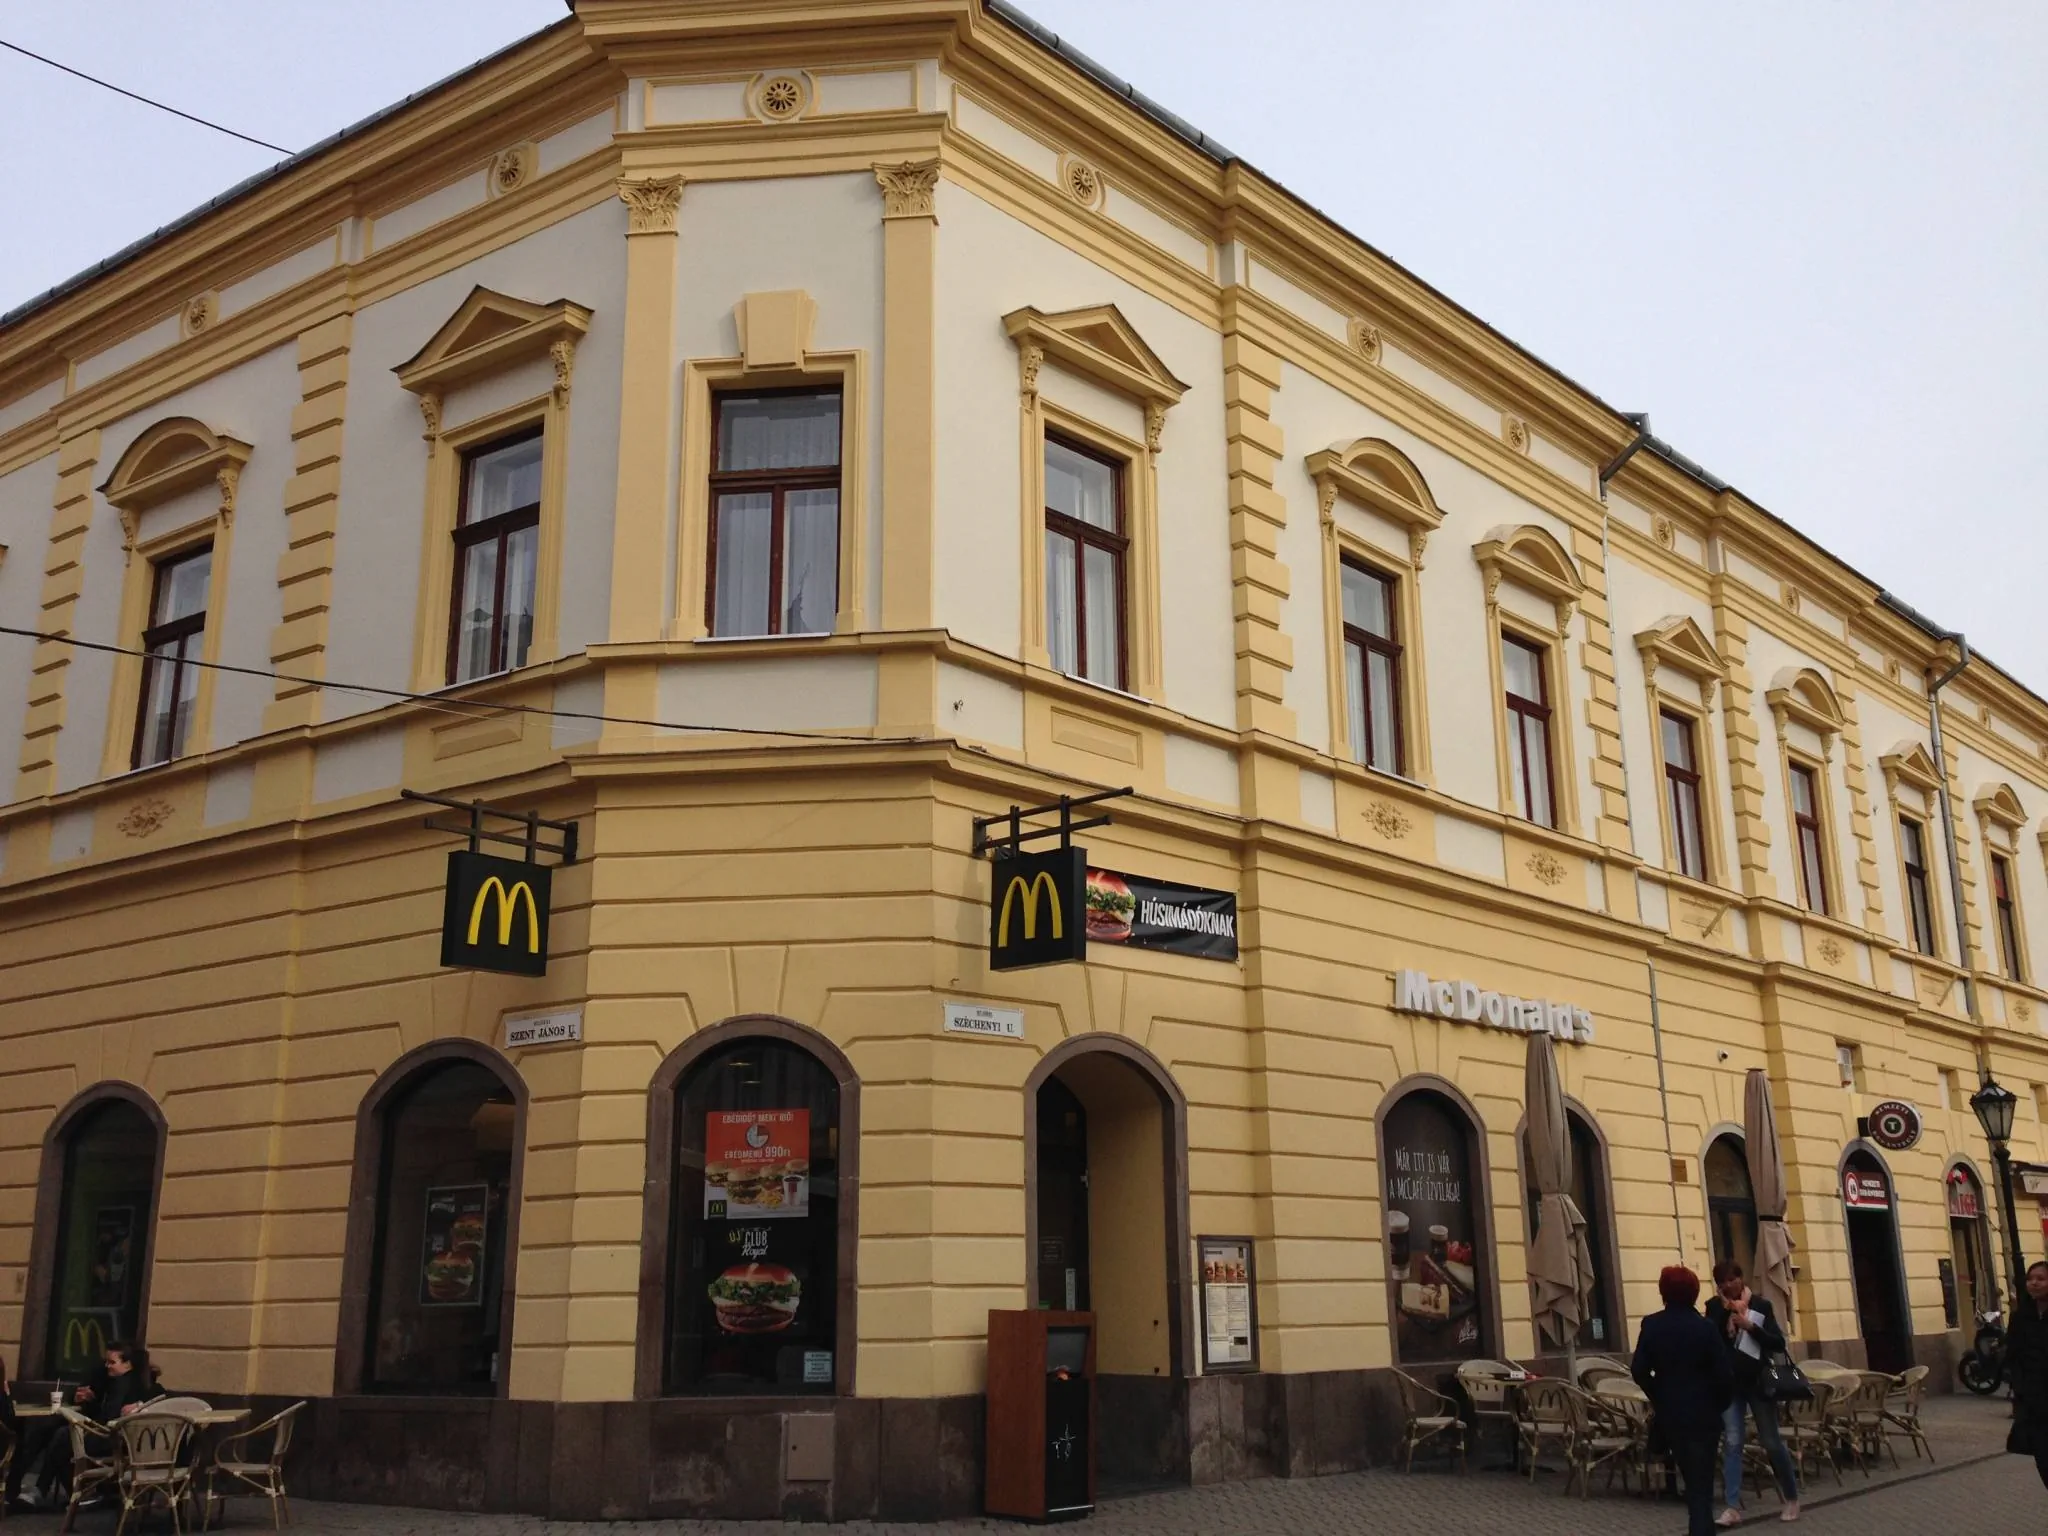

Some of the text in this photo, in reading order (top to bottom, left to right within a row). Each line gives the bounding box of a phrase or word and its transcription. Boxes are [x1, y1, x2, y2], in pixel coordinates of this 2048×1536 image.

[1141, 897, 1236, 938] HÚSIMÁDÓKNAK
[1395, 968, 1595, 1043] McDonald's
[510, 1029, 536, 1042] SZENT
[538, 1024, 566, 1040] JÁNOS
[954, 1016, 1001, 1033] SZÉCHENYI
[744, 1230, 768, 1248] CLUB
